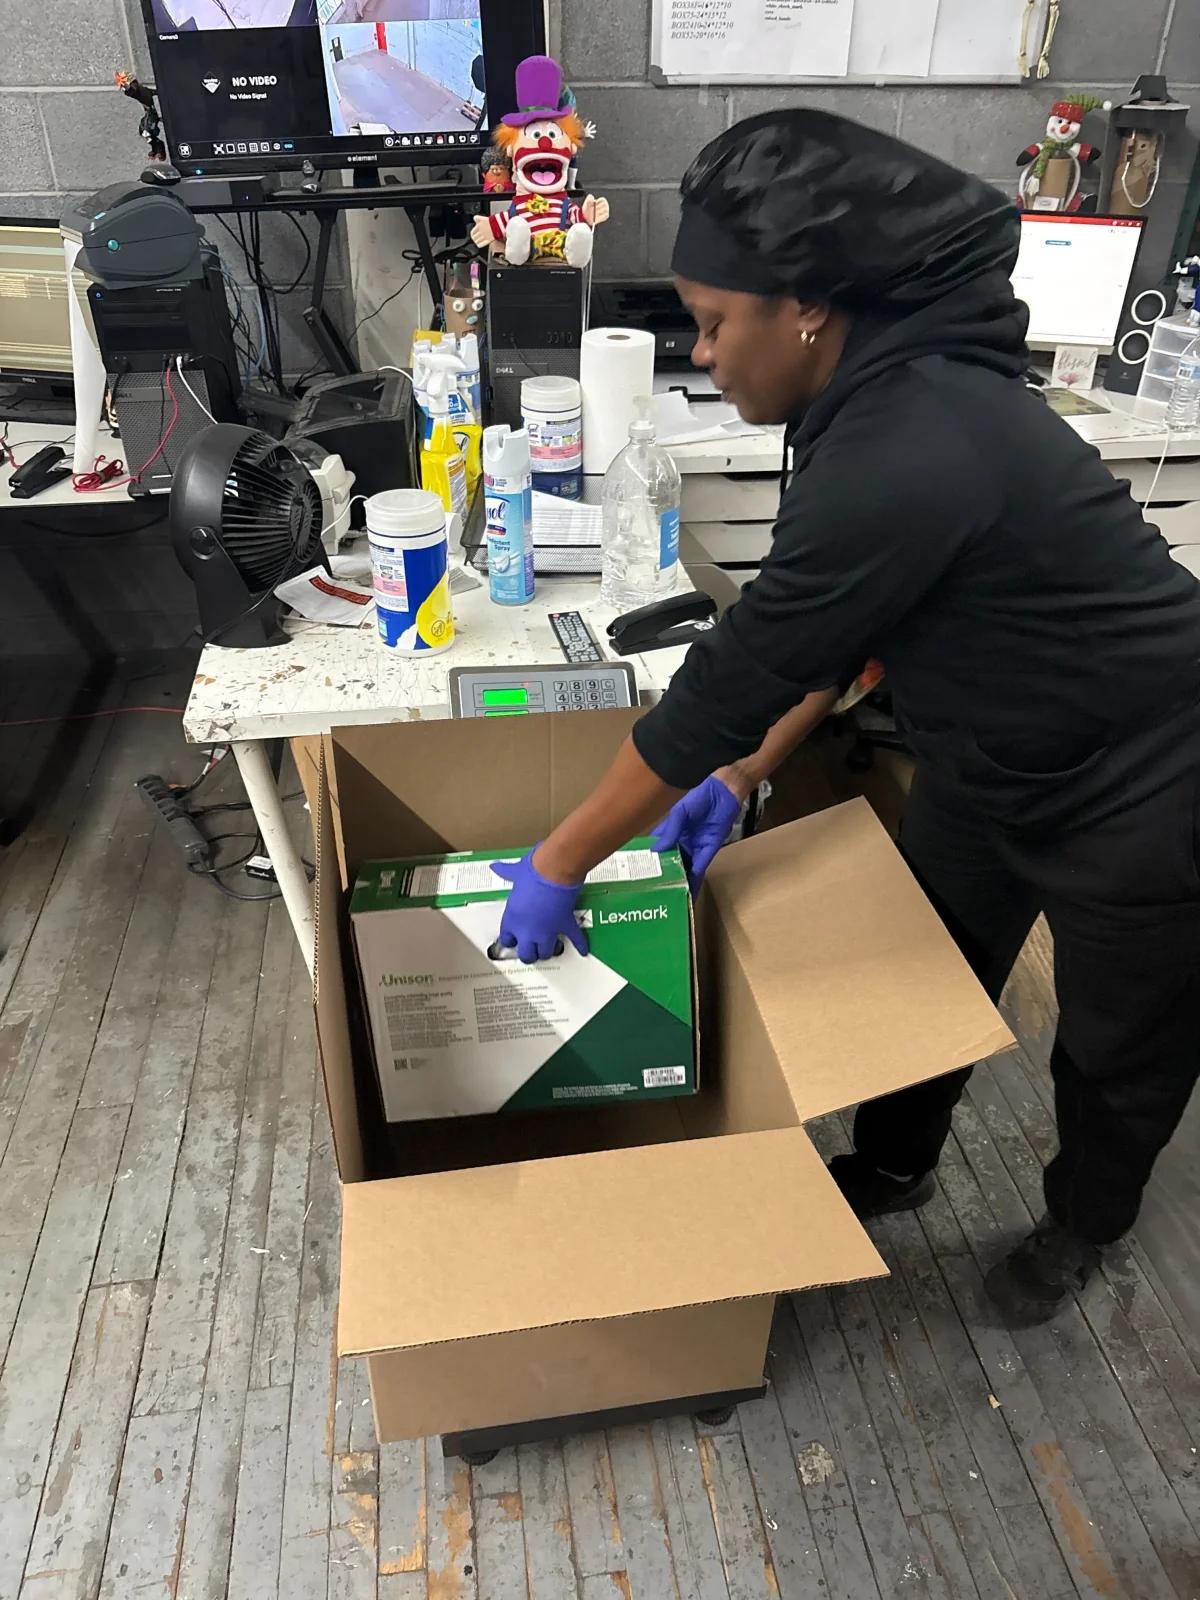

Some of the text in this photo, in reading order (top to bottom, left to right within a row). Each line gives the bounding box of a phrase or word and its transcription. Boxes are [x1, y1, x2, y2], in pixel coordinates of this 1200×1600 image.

[232, 75, 278, 87] NO VIDEO
[252, 92, 267, 100] Signal
[557, 682, 564, 690] 7
[573, 681, 581, 690] 8
[589, 680, 596, 689] 9
[558, 693, 567, 702] 4
[574, 693, 582, 702] 5
[590, 692, 598, 701] 6
[599, 905, 669, 925] Lexmark
[380, 974, 434, 988] Unison
